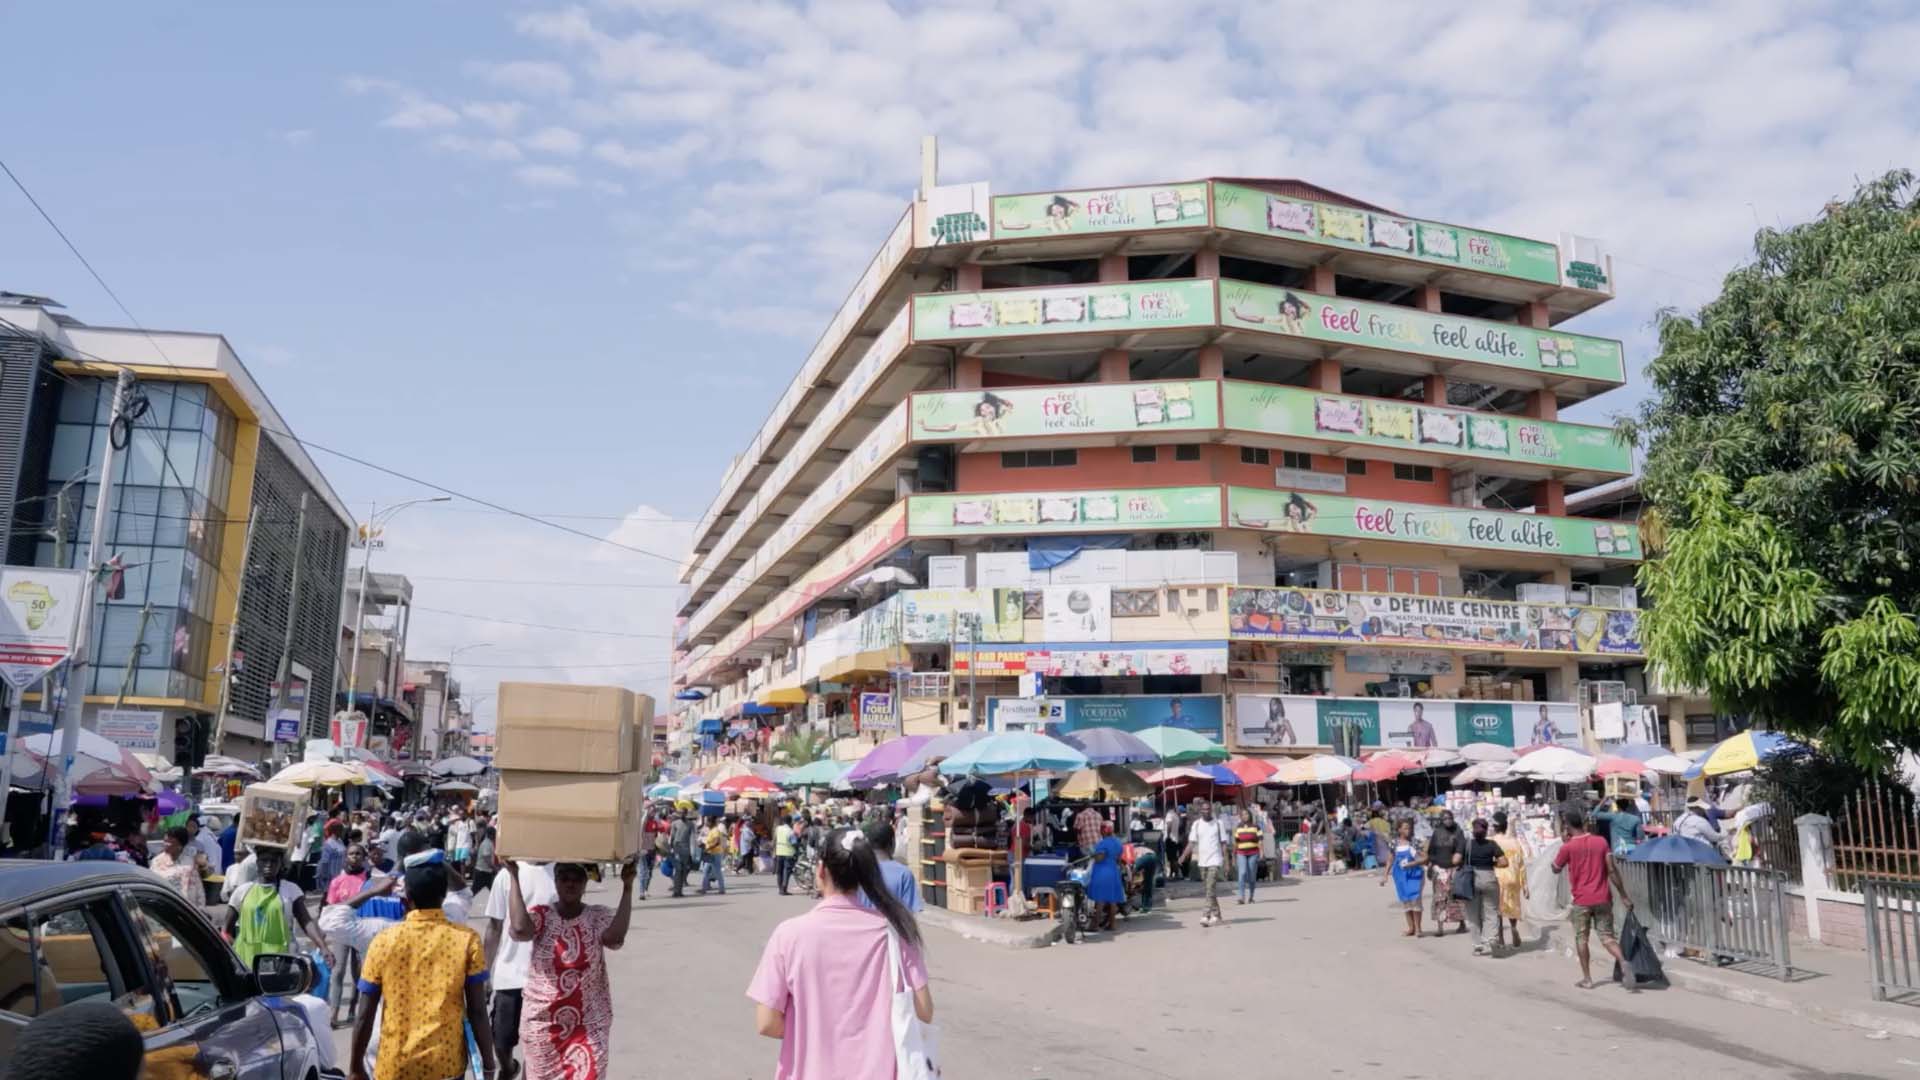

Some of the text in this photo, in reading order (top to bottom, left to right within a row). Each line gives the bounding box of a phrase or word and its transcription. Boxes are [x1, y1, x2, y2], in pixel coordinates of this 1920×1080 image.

[1320, 303, 1361, 334] feel
[1432, 323, 1470, 350] feel
[1475, 330, 1525, 358] alife.
[1354, 506, 1396, 535] feel
[1467, 517, 1506, 543] feel
[1511, 520, 1561, 548] alife.
[32, 599, 46, 610] 50
[1461, 602, 1520, 620] CENTRE
